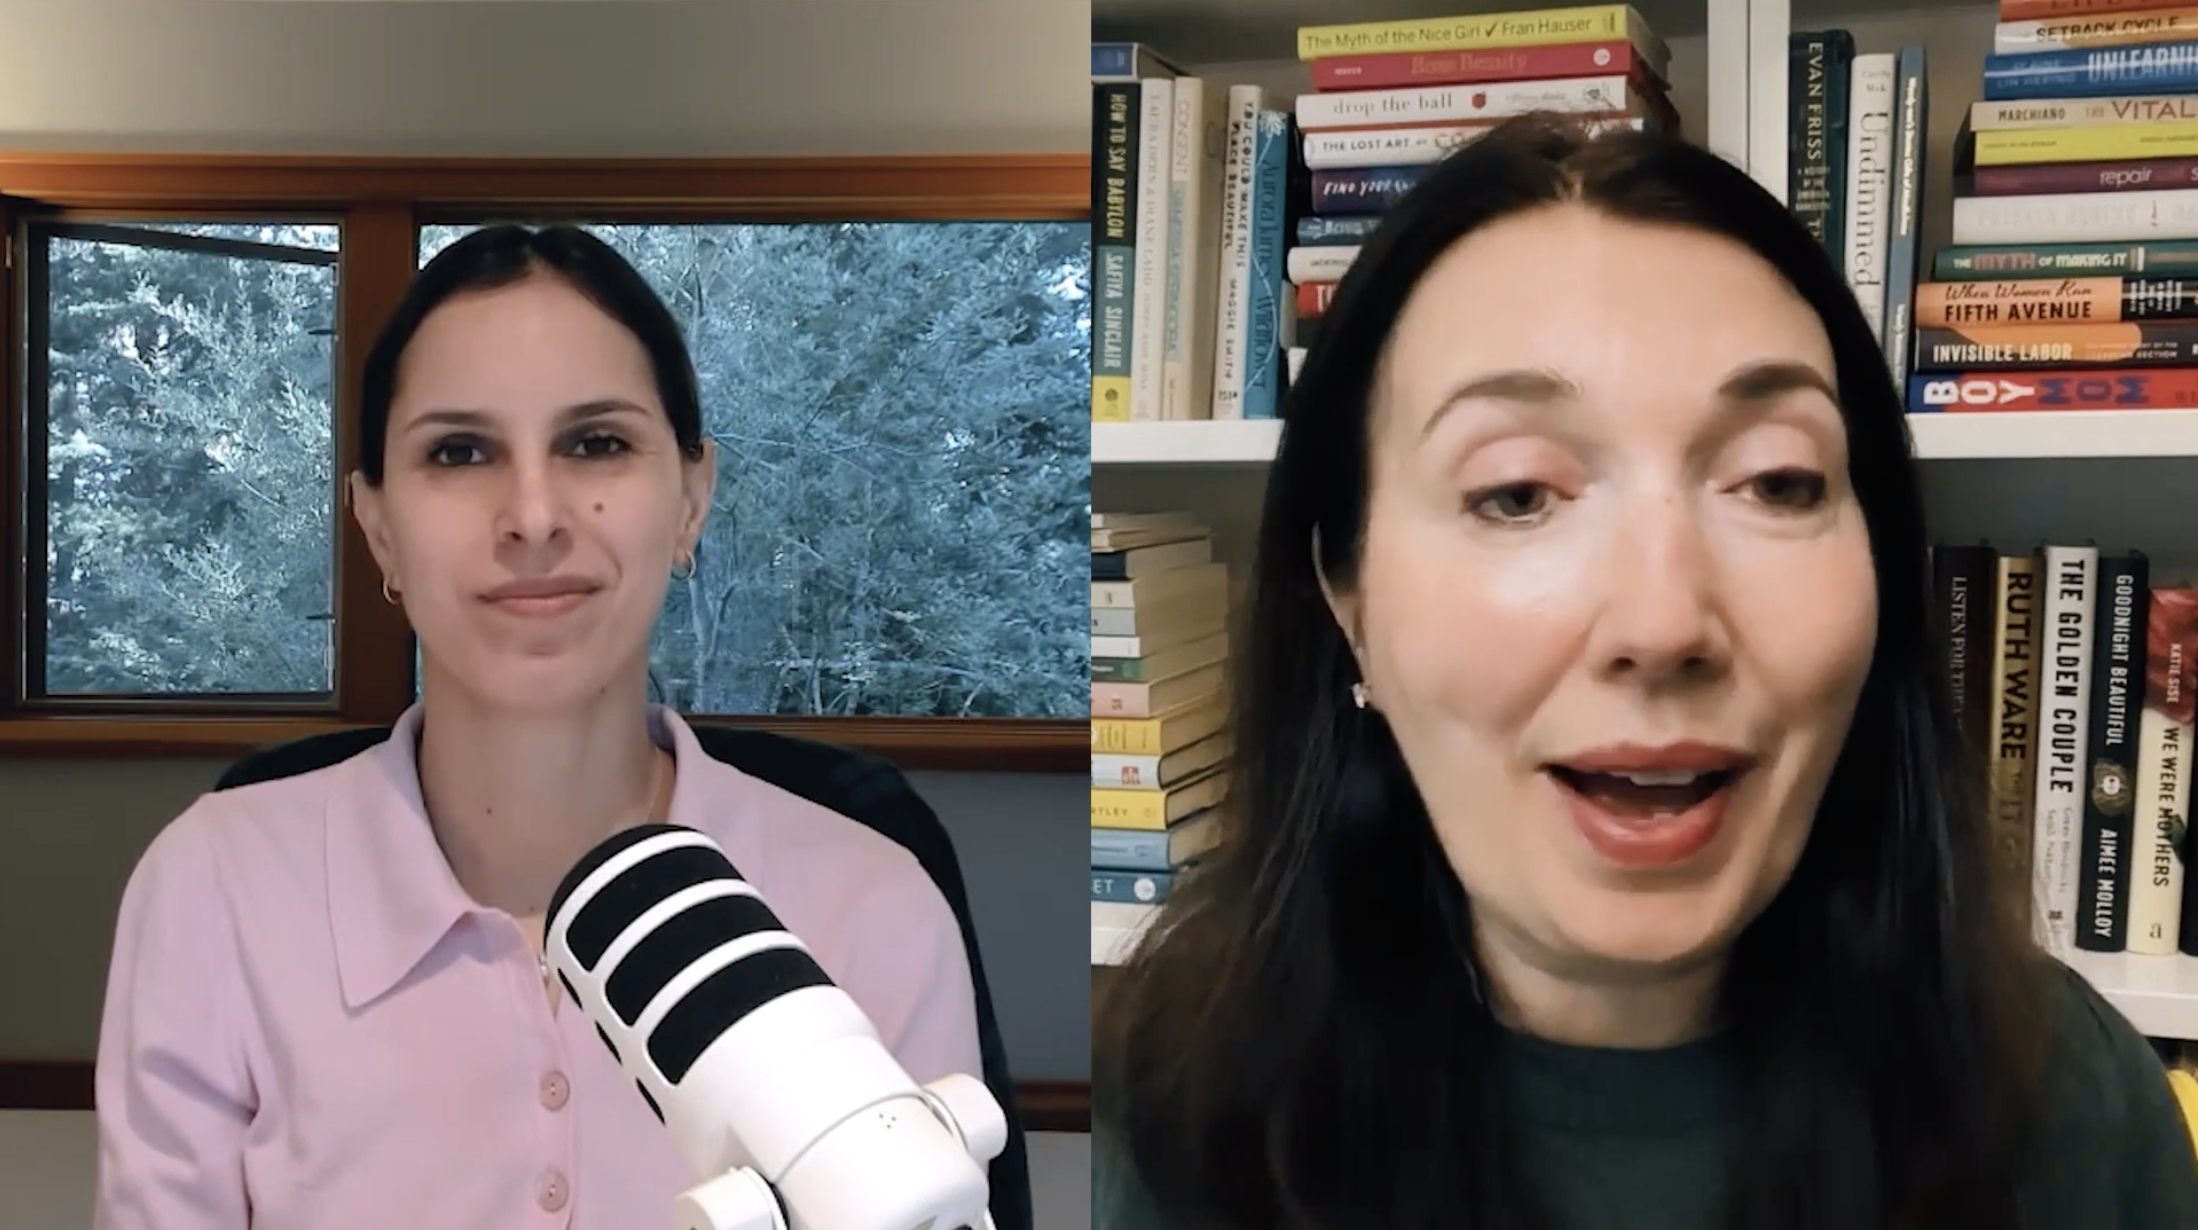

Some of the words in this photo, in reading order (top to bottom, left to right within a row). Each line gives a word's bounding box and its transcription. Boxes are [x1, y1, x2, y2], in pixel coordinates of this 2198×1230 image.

[1305, 35, 1332, 49] The
[1335, 32, 1371, 49] Myth
[1374, 29, 1389, 44] of
[1392, 28, 1415, 43] the
[1419, 27, 1451, 41] Nice
[1454, 25, 1480, 40] Girl
[1501, 21, 1534, 36] Fran
[1538, 18, 1592, 34] Hauser
[1808, 42, 1823, 96] EVAN
[1109, 94, 1127, 122] HOW
[1243, 100, 1255, 130] YOU
[1333, 99, 1374, 117] drop
[1382, 97, 1411, 113] the
[1419, 93, 1452, 110] ball
[1998, 107, 2066, 122] MARCHIANO
[2111, 99, 2197, 120] VITAL
[1109, 127, 1127, 143] TO
[1323, 142, 1346, 152] THE
[1351, 140, 1380, 150] LOST
[1385, 138, 1410, 148] ART
[1807, 104, 1823, 160] FRISS
[1108, 147, 1127, 171] SAY
[1240, 136, 1253, 185] COULD
[1323, 182, 1356, 196] FIND
[2099, 166, 2152, 187] repair
[1106, 178, 1126, 239] BABYLON
[1238, 190, 1250, 231] MAKE
[1854, 112, 1889, 286] Undimmed
[1236, 235, 1248, 268] THIS
[1106, 253, 1123, 299] SAFIYA
[1945, 283, 1989, 300] When
[1945, 304, 1998, 322] FIFTH
[2008, 301, 2092, 321] AVENUE
[1103, 305, 1123, 368] SINCLAIR
[1933, 344, 2013, 363] INVISIBLE
[2019, 343, 2072, 361] LABOR
[1923, 379, 2034, 405] BOY
[2038, 376, 2149, 405] MOM
[2059, 560, 2085, 601] THE
[1952, 576, 1967, 634] LISTEN
[2004, 572, 2033, 661] RUTH
[2111, 574, 2134, 662] GOODNIGHT
[1951, 637, 1966, 669] FOR
[2055, 612, 2082, 697] GOLDEN
[2168, 643, 2182, 676] KATIE
[2106, 667, 2128, 746] BEAUTIFUL
[2166, 677, 2181, 704] SISE
[2001, 669, 2029, 759] WARE
[2050, 708, 2077, 793] COUPLE
[2161, 726, 2180, 753] WE
[2158, 755, 2178, 803] WERE
[2097, 828, 2118, 874] AIMEE
[2153, 807, 2174, 888] MOTHERS
[1091, 879, 1114, 894] ET
[2094, 879, 2115, 938] MOLLOY
